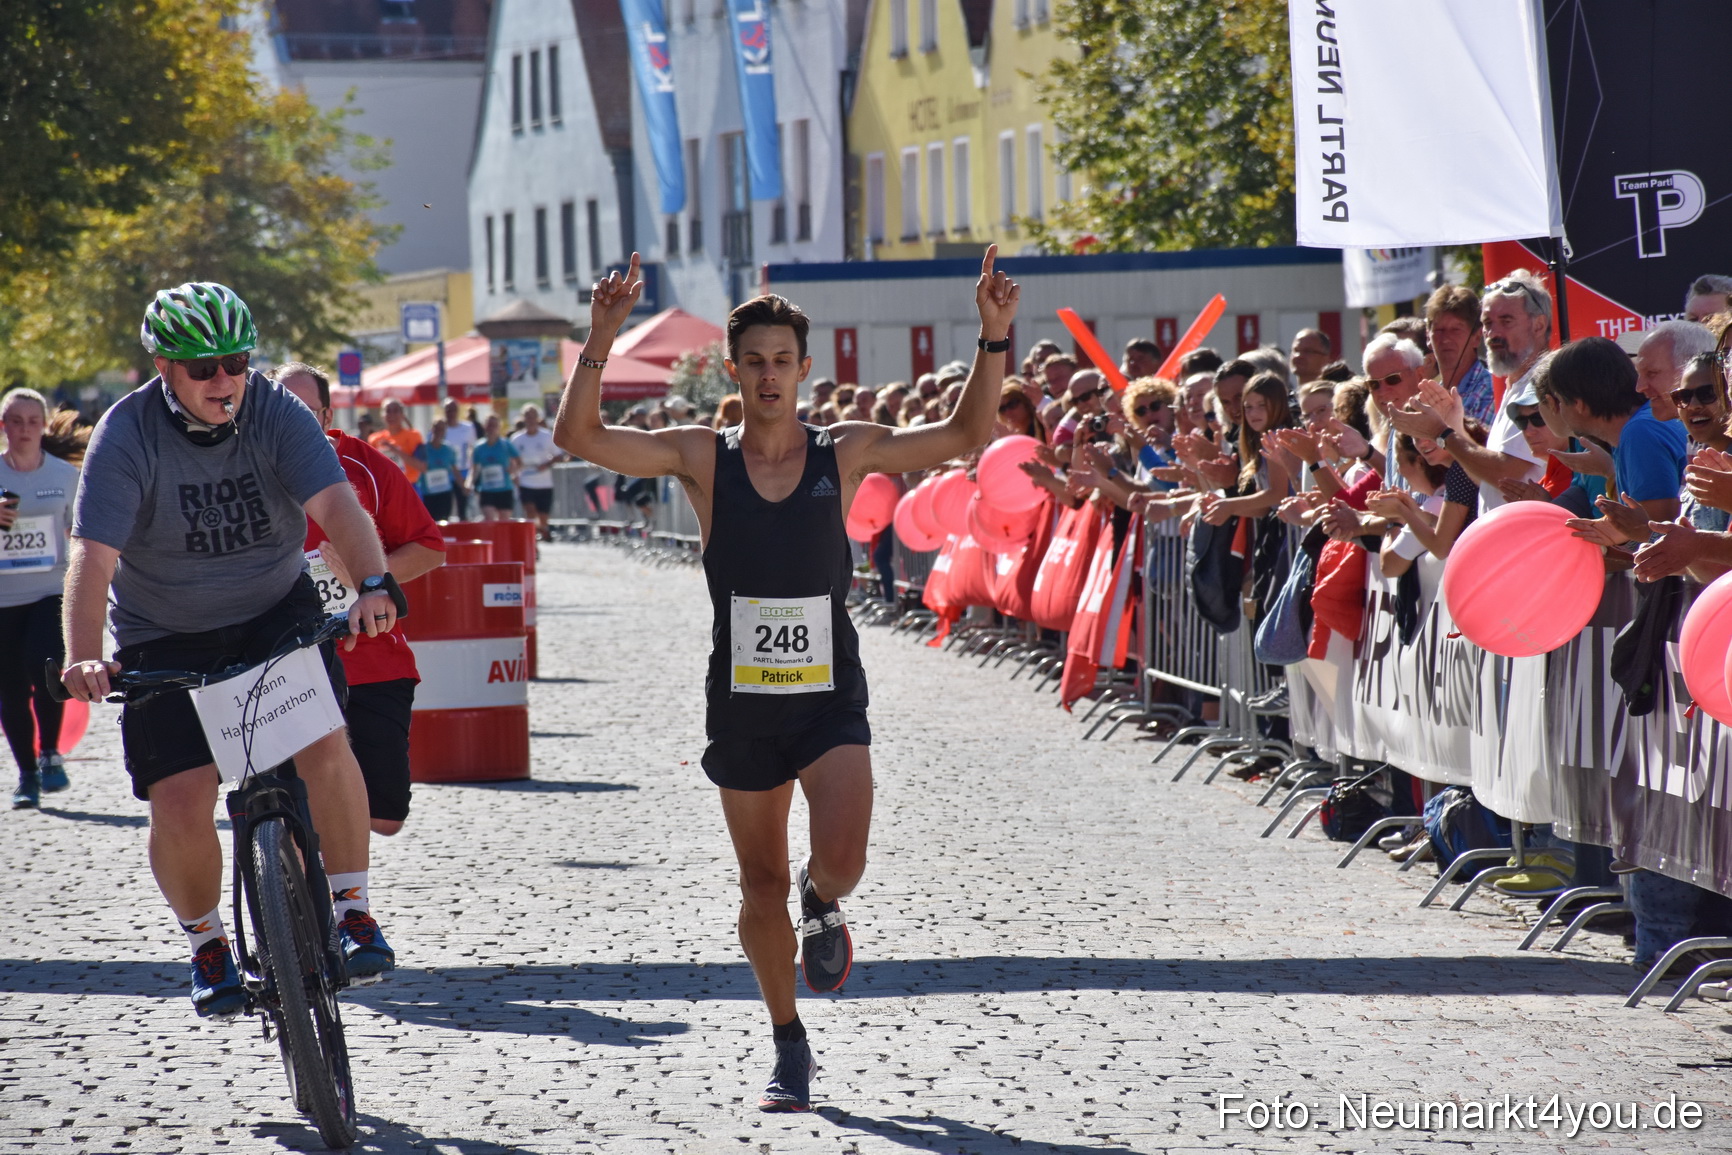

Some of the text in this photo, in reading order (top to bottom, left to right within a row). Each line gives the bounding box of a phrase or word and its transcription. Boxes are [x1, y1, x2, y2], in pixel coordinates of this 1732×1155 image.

[1620, 180, 1649, 191] Team
[1596, 316, 1636, 338] THE
[178, 472, 261, 511] RIDE
[3, 532, 46, 551] 2323
[185, 518, 273, 554] BIKE
[760, 606, 804, 617] BOCK
[755, 625, 809, 654] 248
[753, 656, 773, 664] PARTL
[762, 670, 804, 683] Patrick
[221, 688, 317, 740] Halbmarathon
